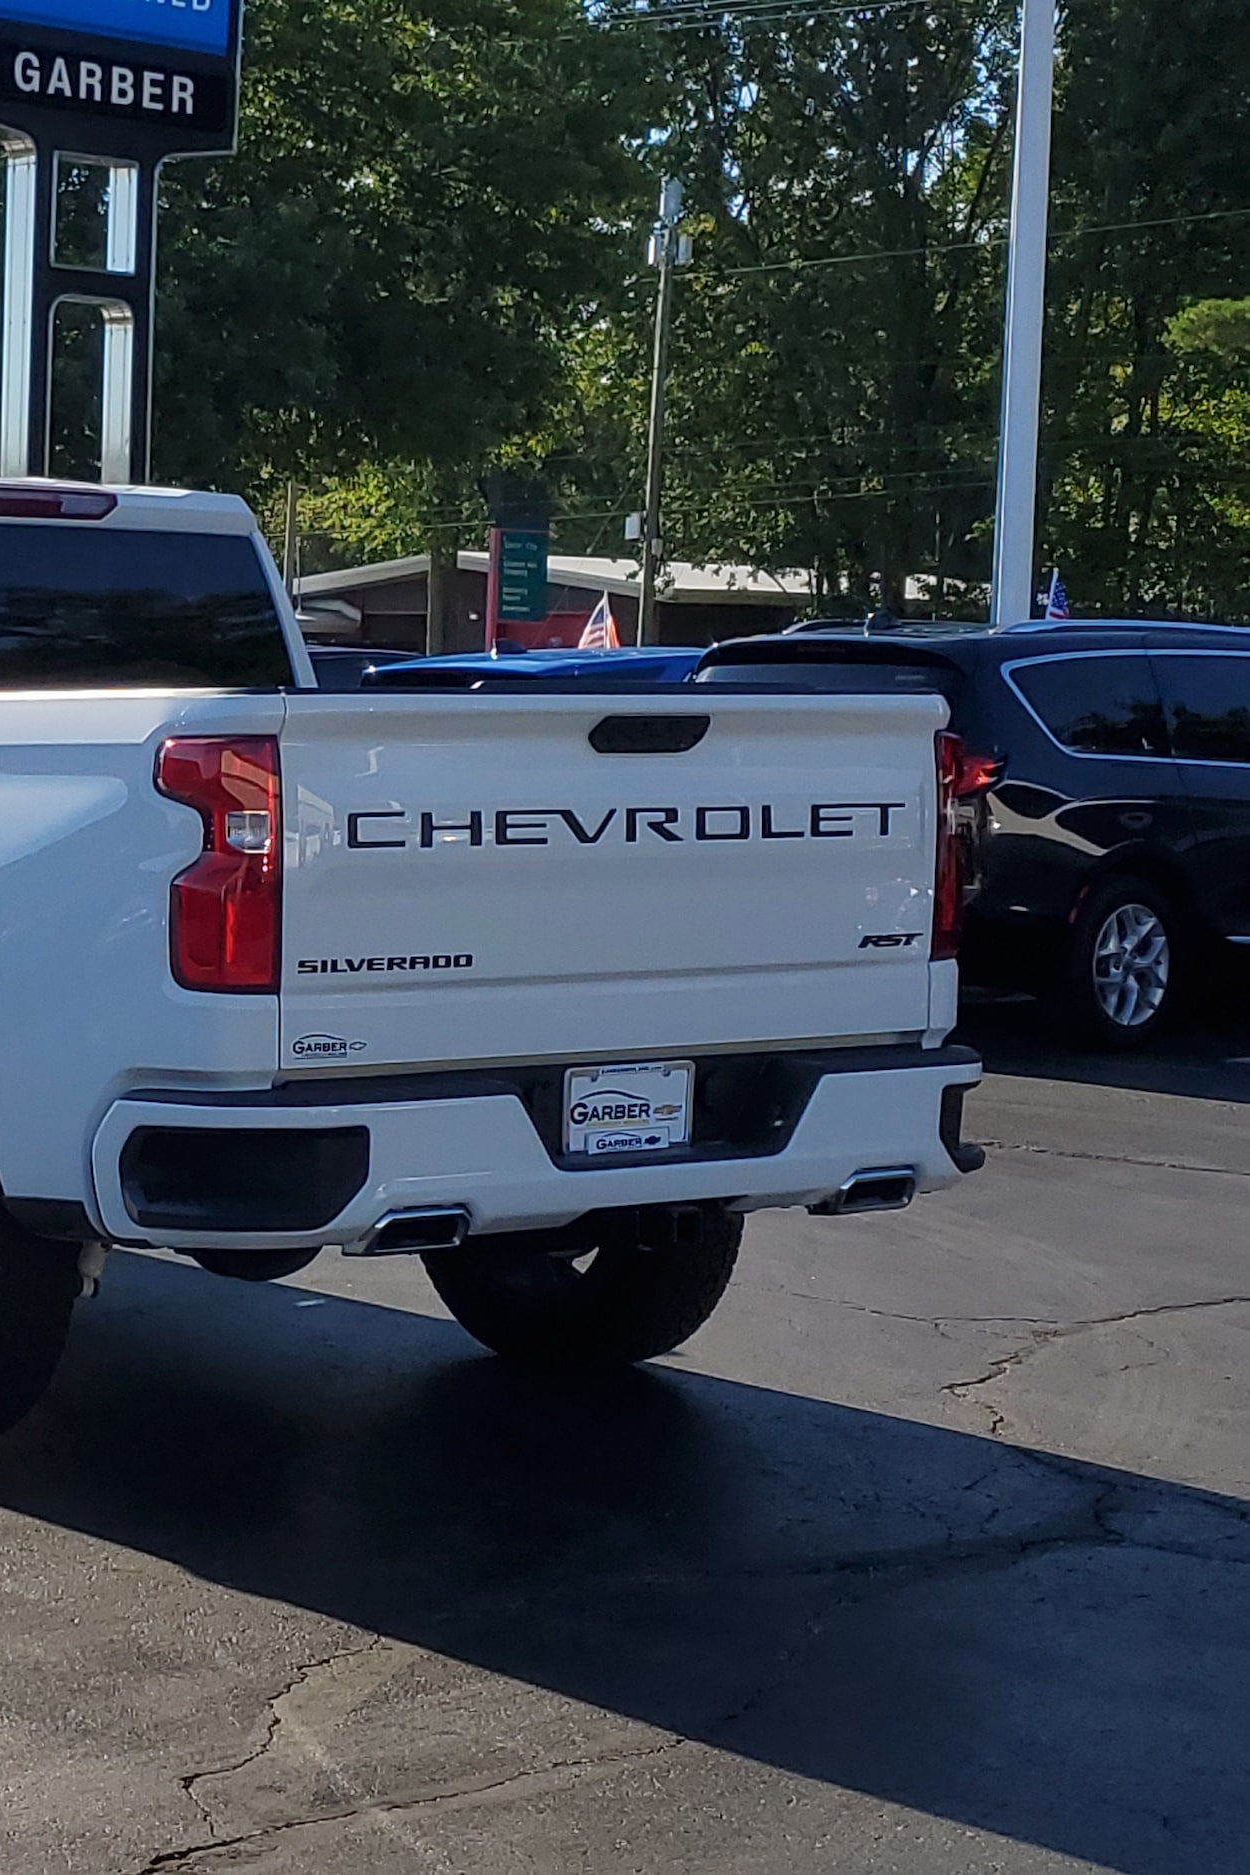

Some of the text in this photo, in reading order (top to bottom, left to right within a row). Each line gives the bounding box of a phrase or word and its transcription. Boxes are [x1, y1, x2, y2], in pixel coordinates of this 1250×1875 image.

[13, 51, 194, 115] GARBER
[347, 802, 906, 849] CHEVROLET
[857, 932, 924, 949] RST
[297, 954, 473, 974] SILVERADO
[292, 1040, 347, 1055] GARBER
[570, 1102, 651, 1125] GARBER
